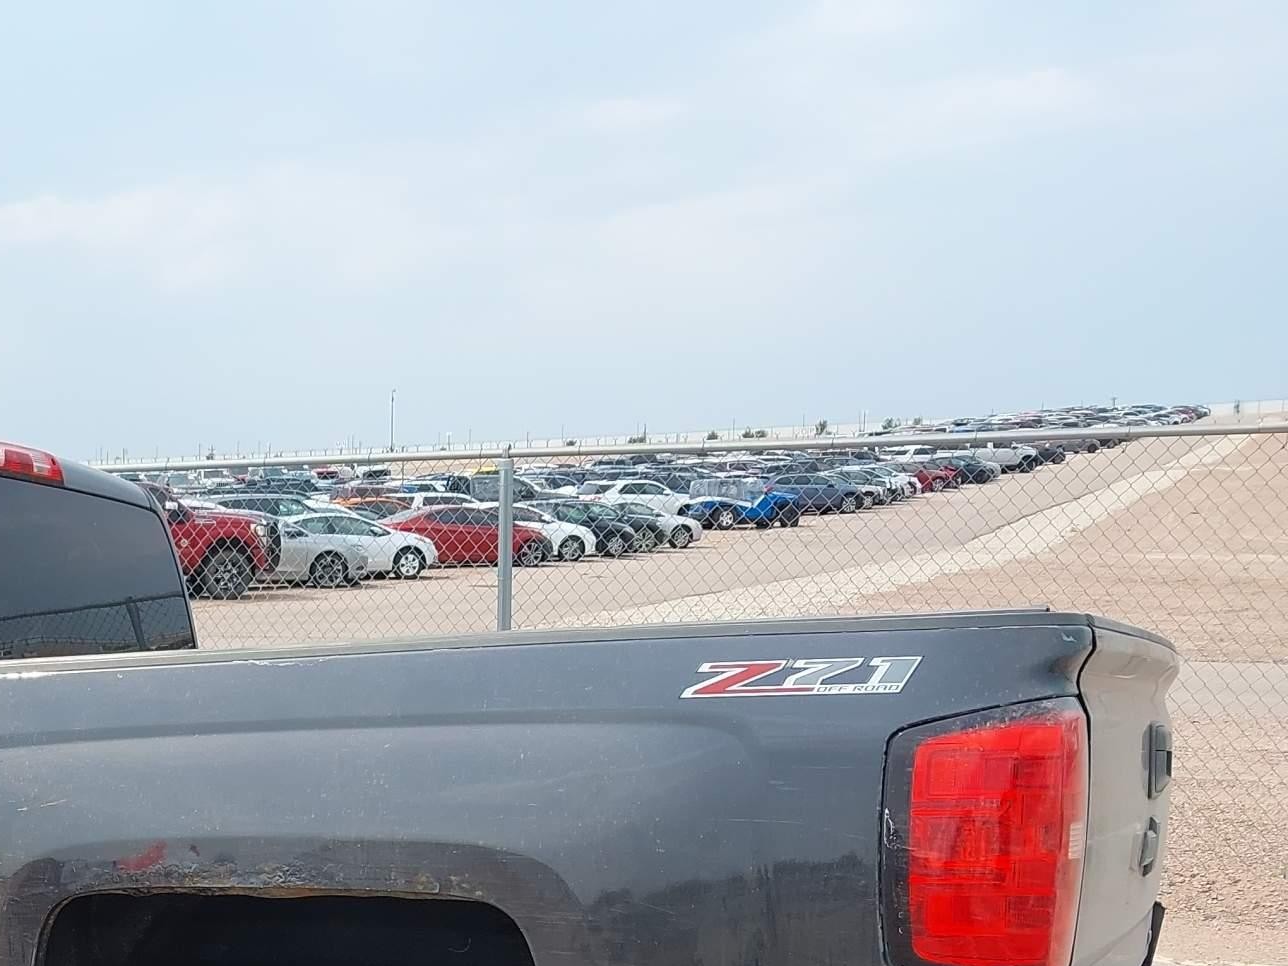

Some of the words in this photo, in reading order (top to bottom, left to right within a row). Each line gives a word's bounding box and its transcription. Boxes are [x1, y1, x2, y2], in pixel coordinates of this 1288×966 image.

[679, 655, 925, 699] Z71
[816, 685, 848, 694] OFF
[853, 683, 901, 693] ROAD
